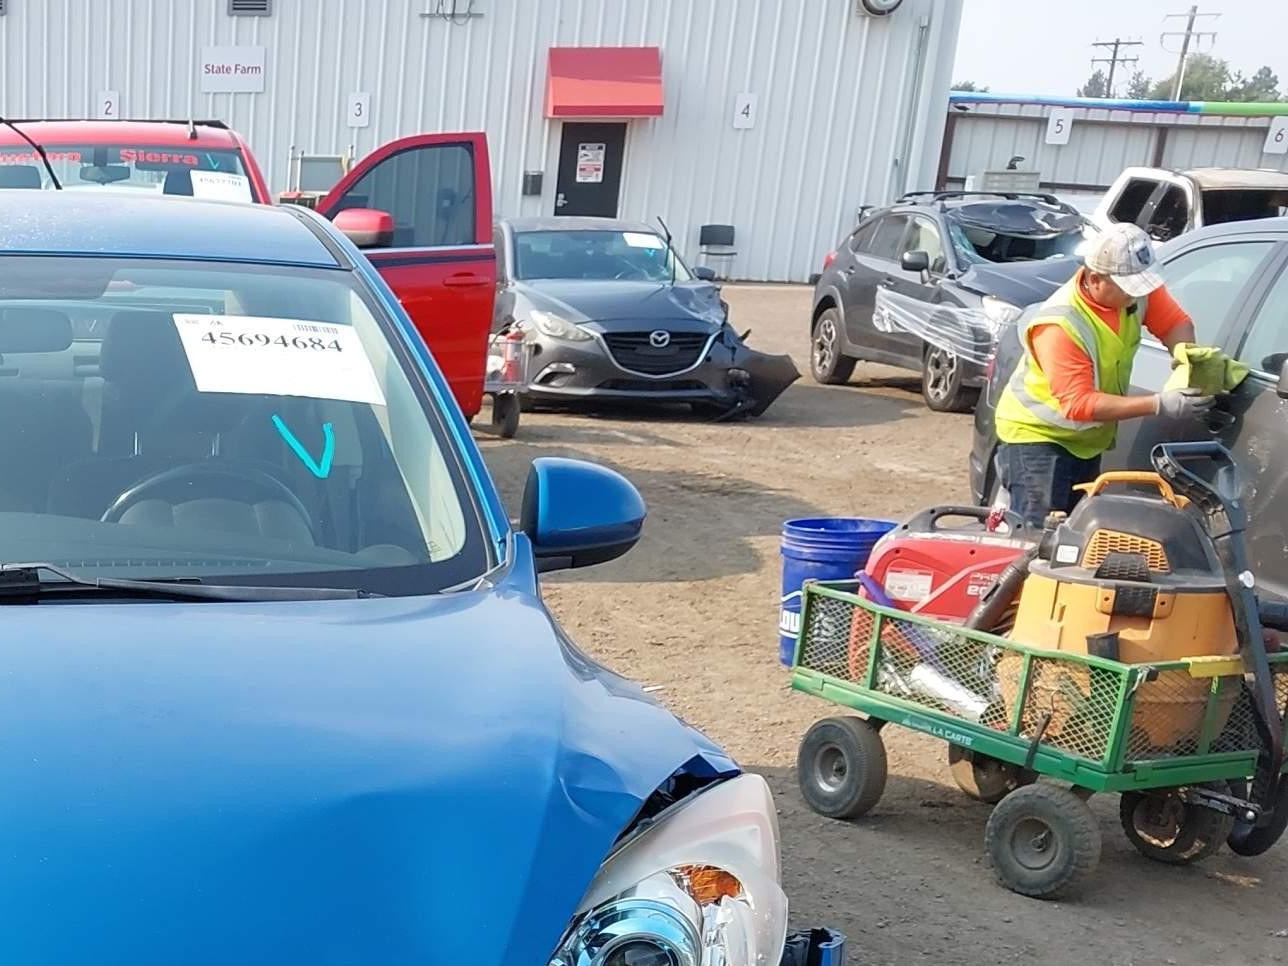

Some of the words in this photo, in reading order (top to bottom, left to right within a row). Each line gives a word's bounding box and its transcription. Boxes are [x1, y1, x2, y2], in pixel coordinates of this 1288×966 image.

[204, 63, 232, 75] State
[234, 63, 261, 75] Farm
[104, 100, 113, 115] 2
[354, 102, 362, 117] 3
[741, 103, 750, 118] 4
[1055, 118, 1064, 134] 5
[1274, 127, 1285, 143] 6
[119, 148, 199, 166] Sierra
[201, 330, 343, 352] 45694684
